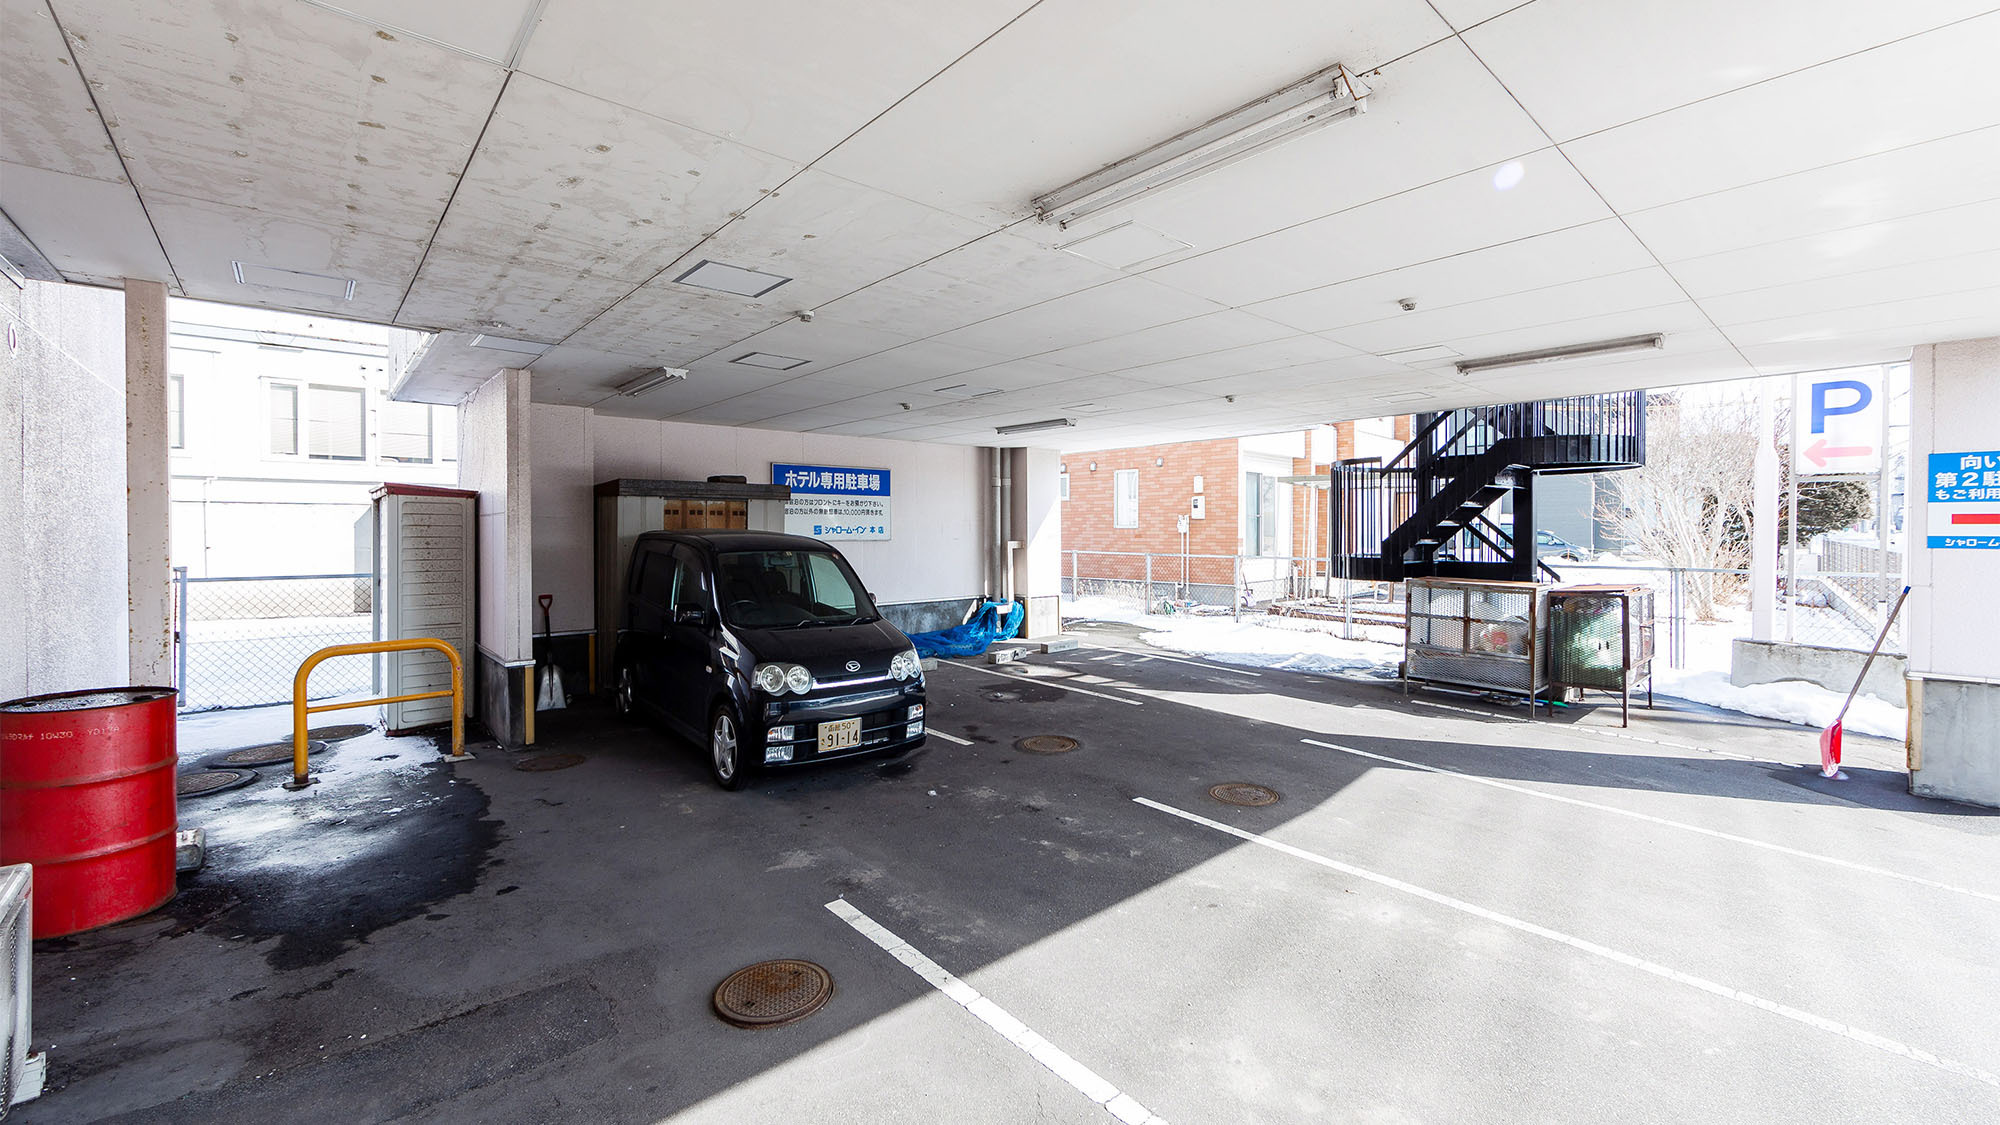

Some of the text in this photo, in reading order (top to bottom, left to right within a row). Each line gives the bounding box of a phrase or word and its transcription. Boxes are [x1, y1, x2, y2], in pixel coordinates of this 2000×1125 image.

[1811, 380, 1872, 433] P
[785, 470, 880, 491] ホテル専用駐車場
[825, 525, 867, 534] シャローム・イン
[841, 721, 851, 730] 50
[827, 729, 858, 747] 91-14
